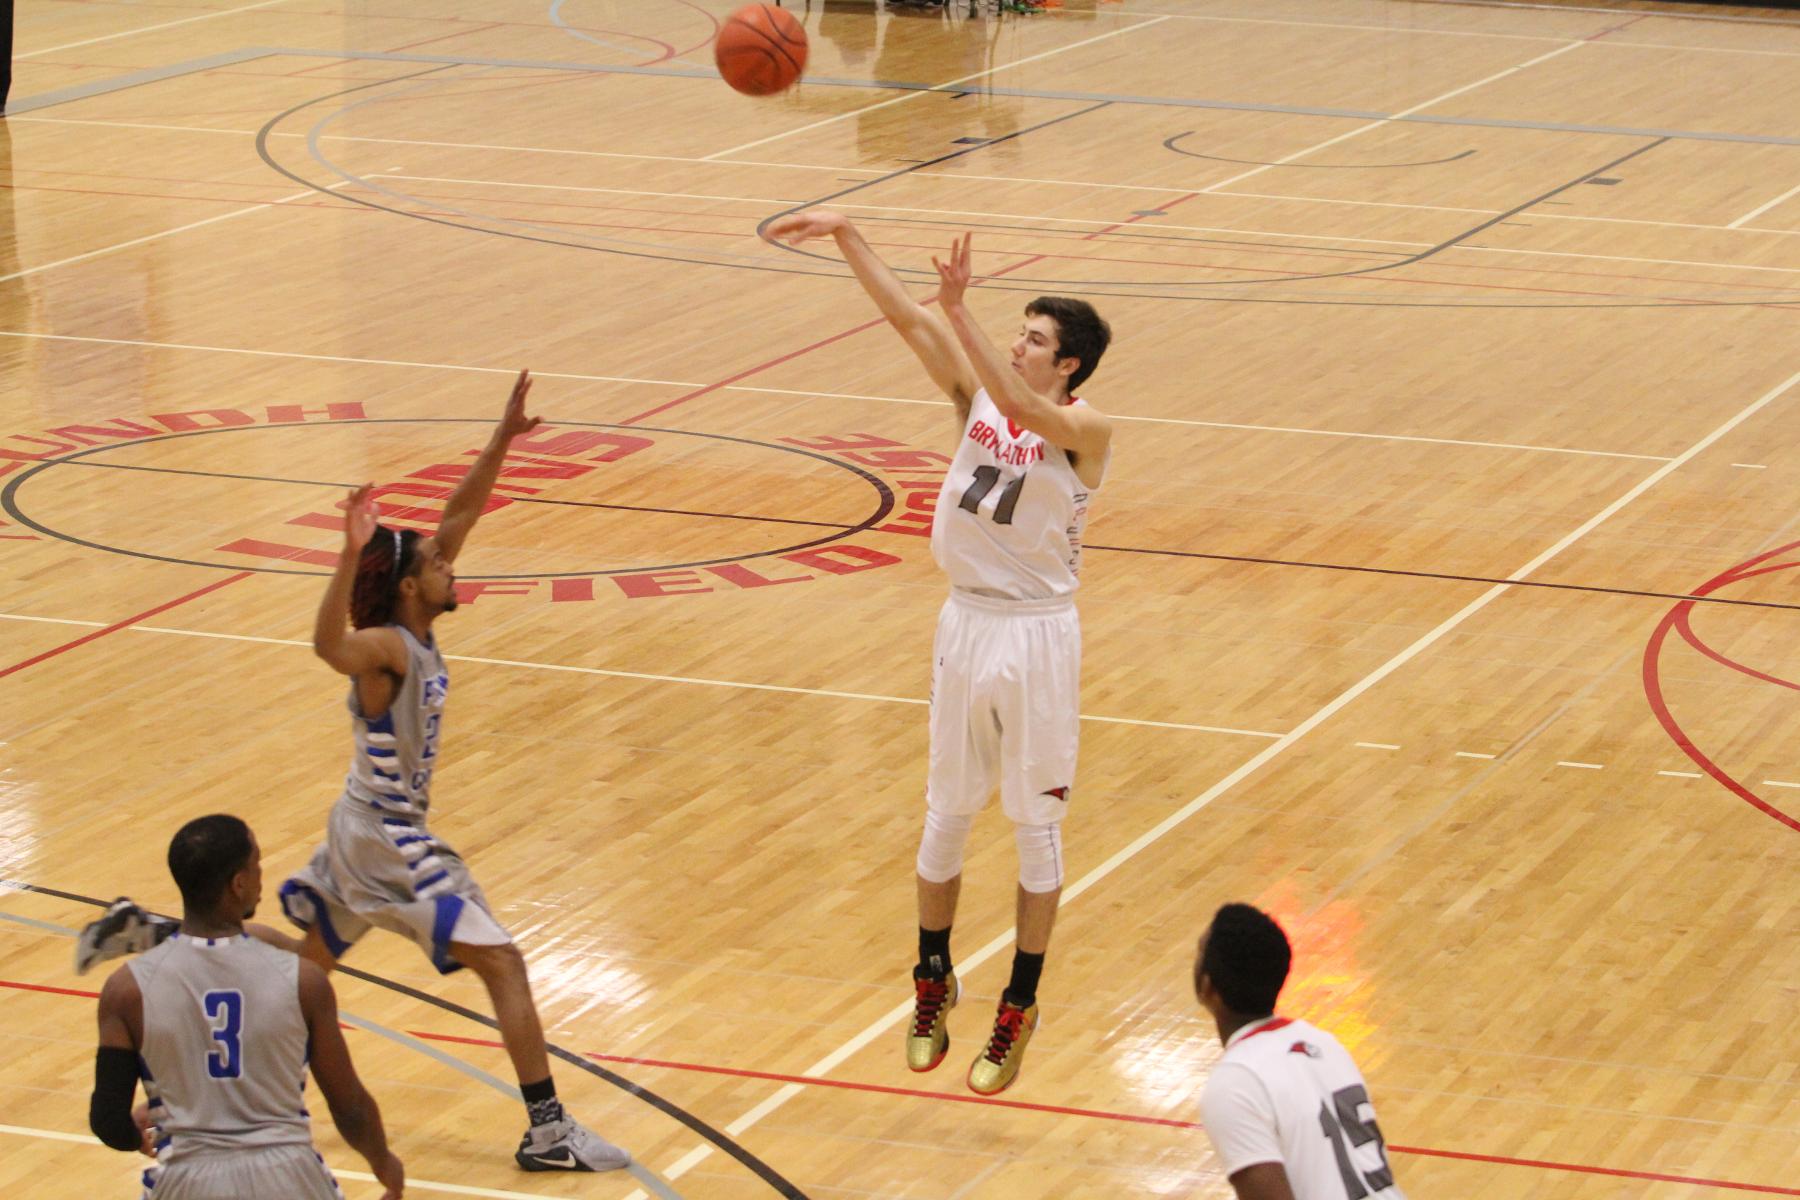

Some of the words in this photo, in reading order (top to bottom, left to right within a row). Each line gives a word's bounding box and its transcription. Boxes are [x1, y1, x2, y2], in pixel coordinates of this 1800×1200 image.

[213, 424, 655, 568] LIONS
[958, 465, 1026, 525] 11
[452, 544, 903, 605] FIELD
[204, 989, 242, 1079] 3
[1319, 1083, 1394, 1200] 15
